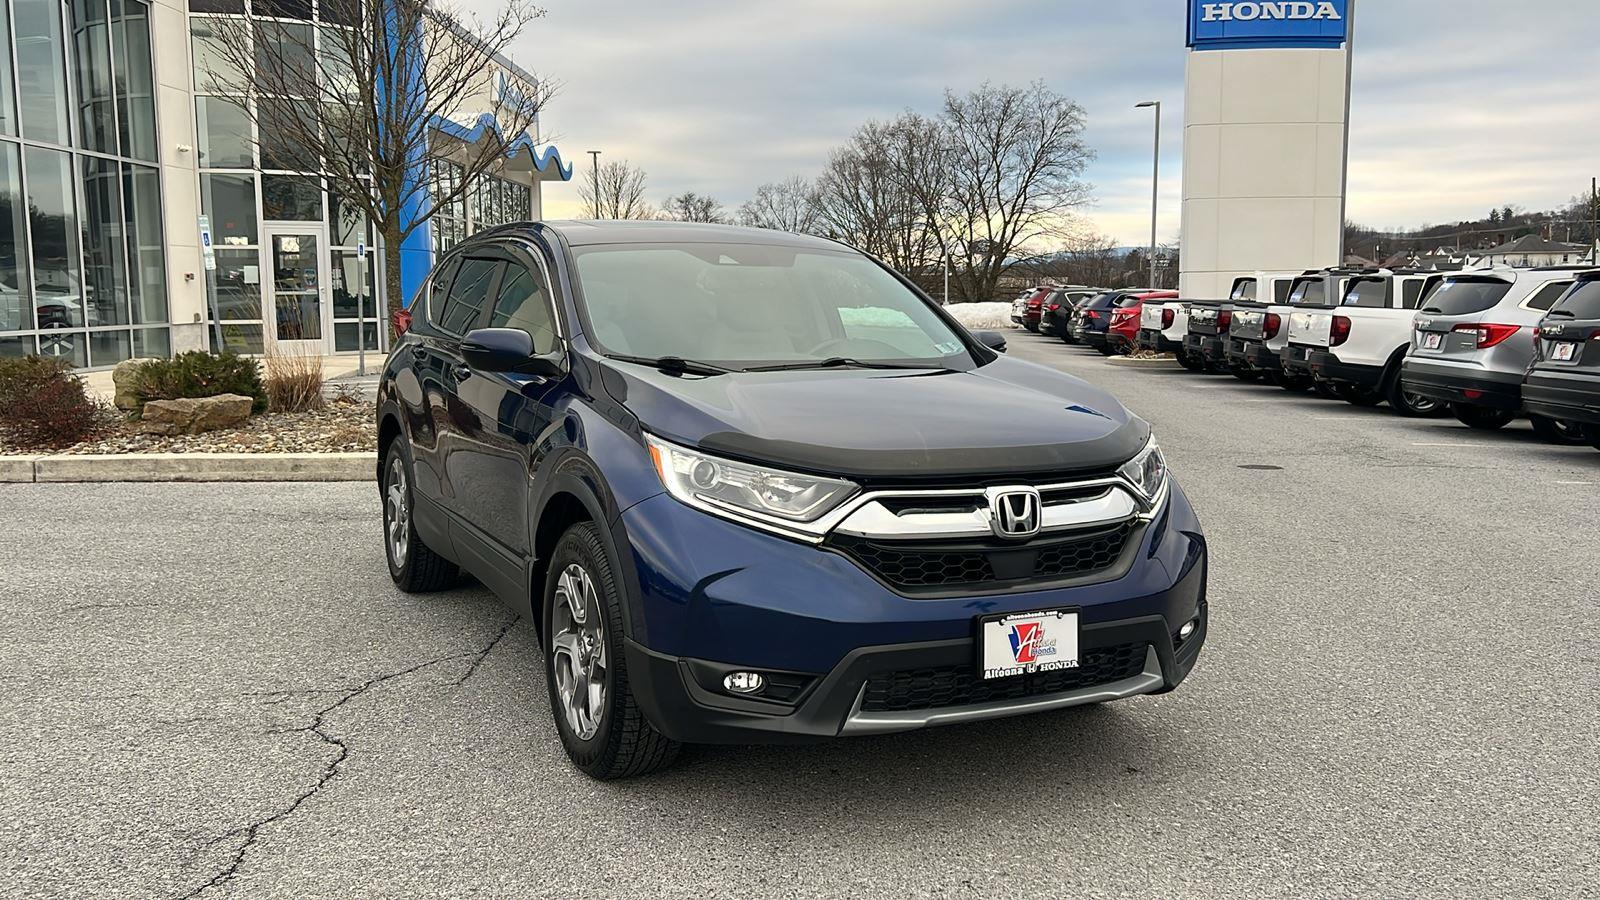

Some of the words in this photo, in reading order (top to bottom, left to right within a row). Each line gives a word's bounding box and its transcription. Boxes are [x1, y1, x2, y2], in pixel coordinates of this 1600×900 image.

[1202, 2, 1341, 21] HONDA
[984, 668, 1024, 679] Altoona
[1040, 660, 1079, 671] HONDA
